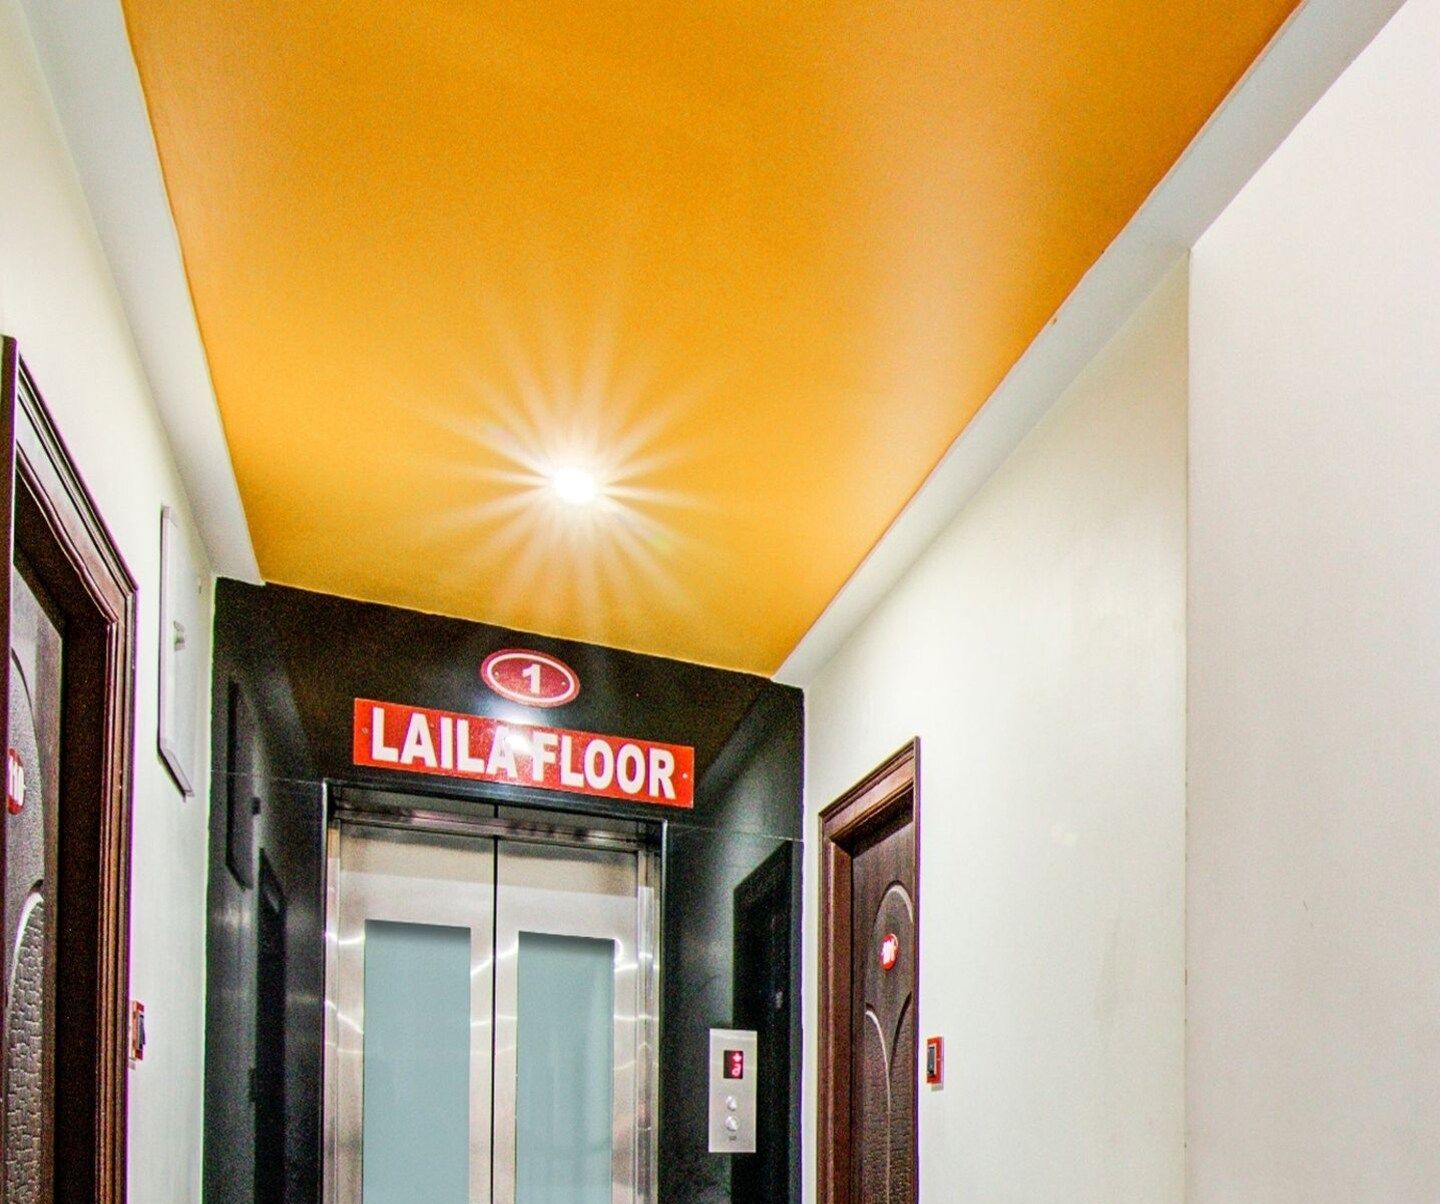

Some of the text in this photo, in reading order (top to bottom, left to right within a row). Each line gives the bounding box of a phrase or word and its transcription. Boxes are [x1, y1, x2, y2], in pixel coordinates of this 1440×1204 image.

[521, 663, 541, 695] 1
[371, 707, 676, 800] LAILA FLOOR
